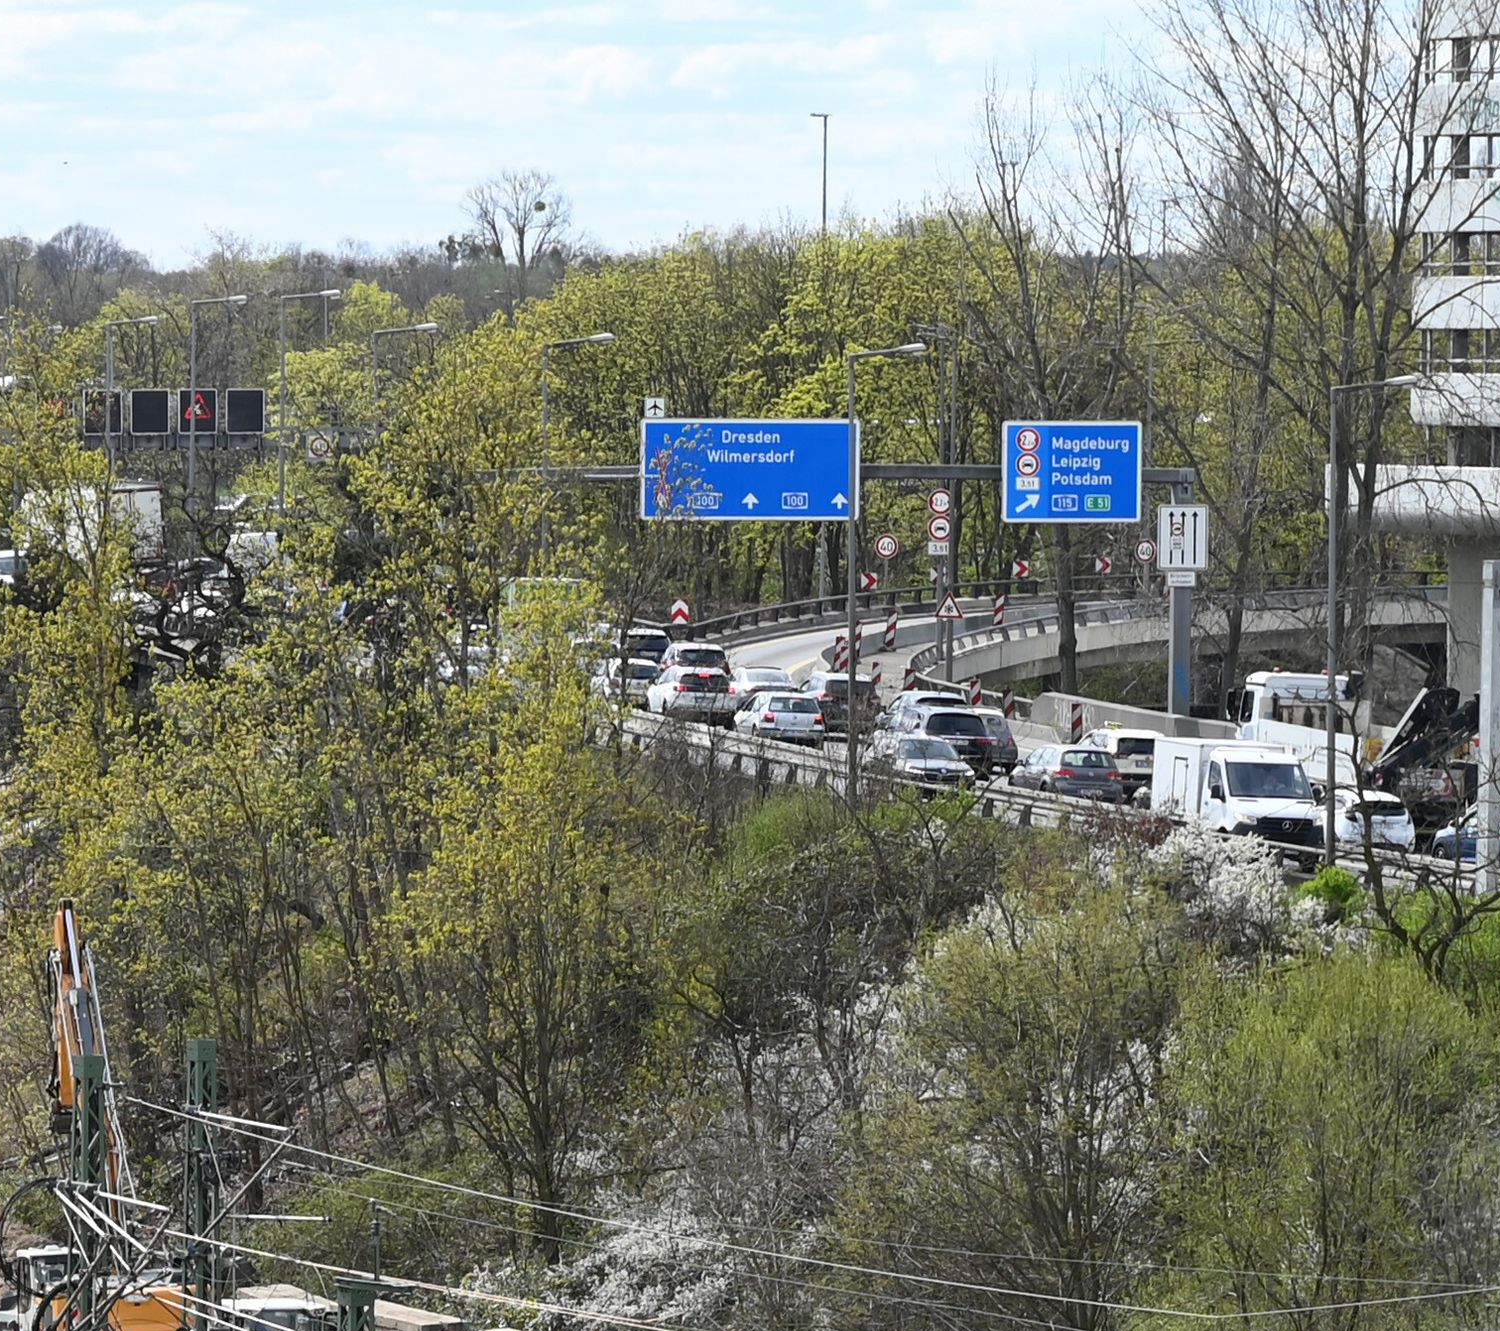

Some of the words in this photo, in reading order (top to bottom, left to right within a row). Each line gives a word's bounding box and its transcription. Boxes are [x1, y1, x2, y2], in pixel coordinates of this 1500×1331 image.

[721, 430, 781, 444] Dresden
[1051, 437, 1130, 453] Magdeburg
[707, 449, 795, 464] Wilmersdorf
[1051, 454, 1101, 471] Leipzig
[1051, 472, 1112, 486] Potsdam
[786, 495, 804, 506] 100
[1057, 497, 1072, 508] 115
